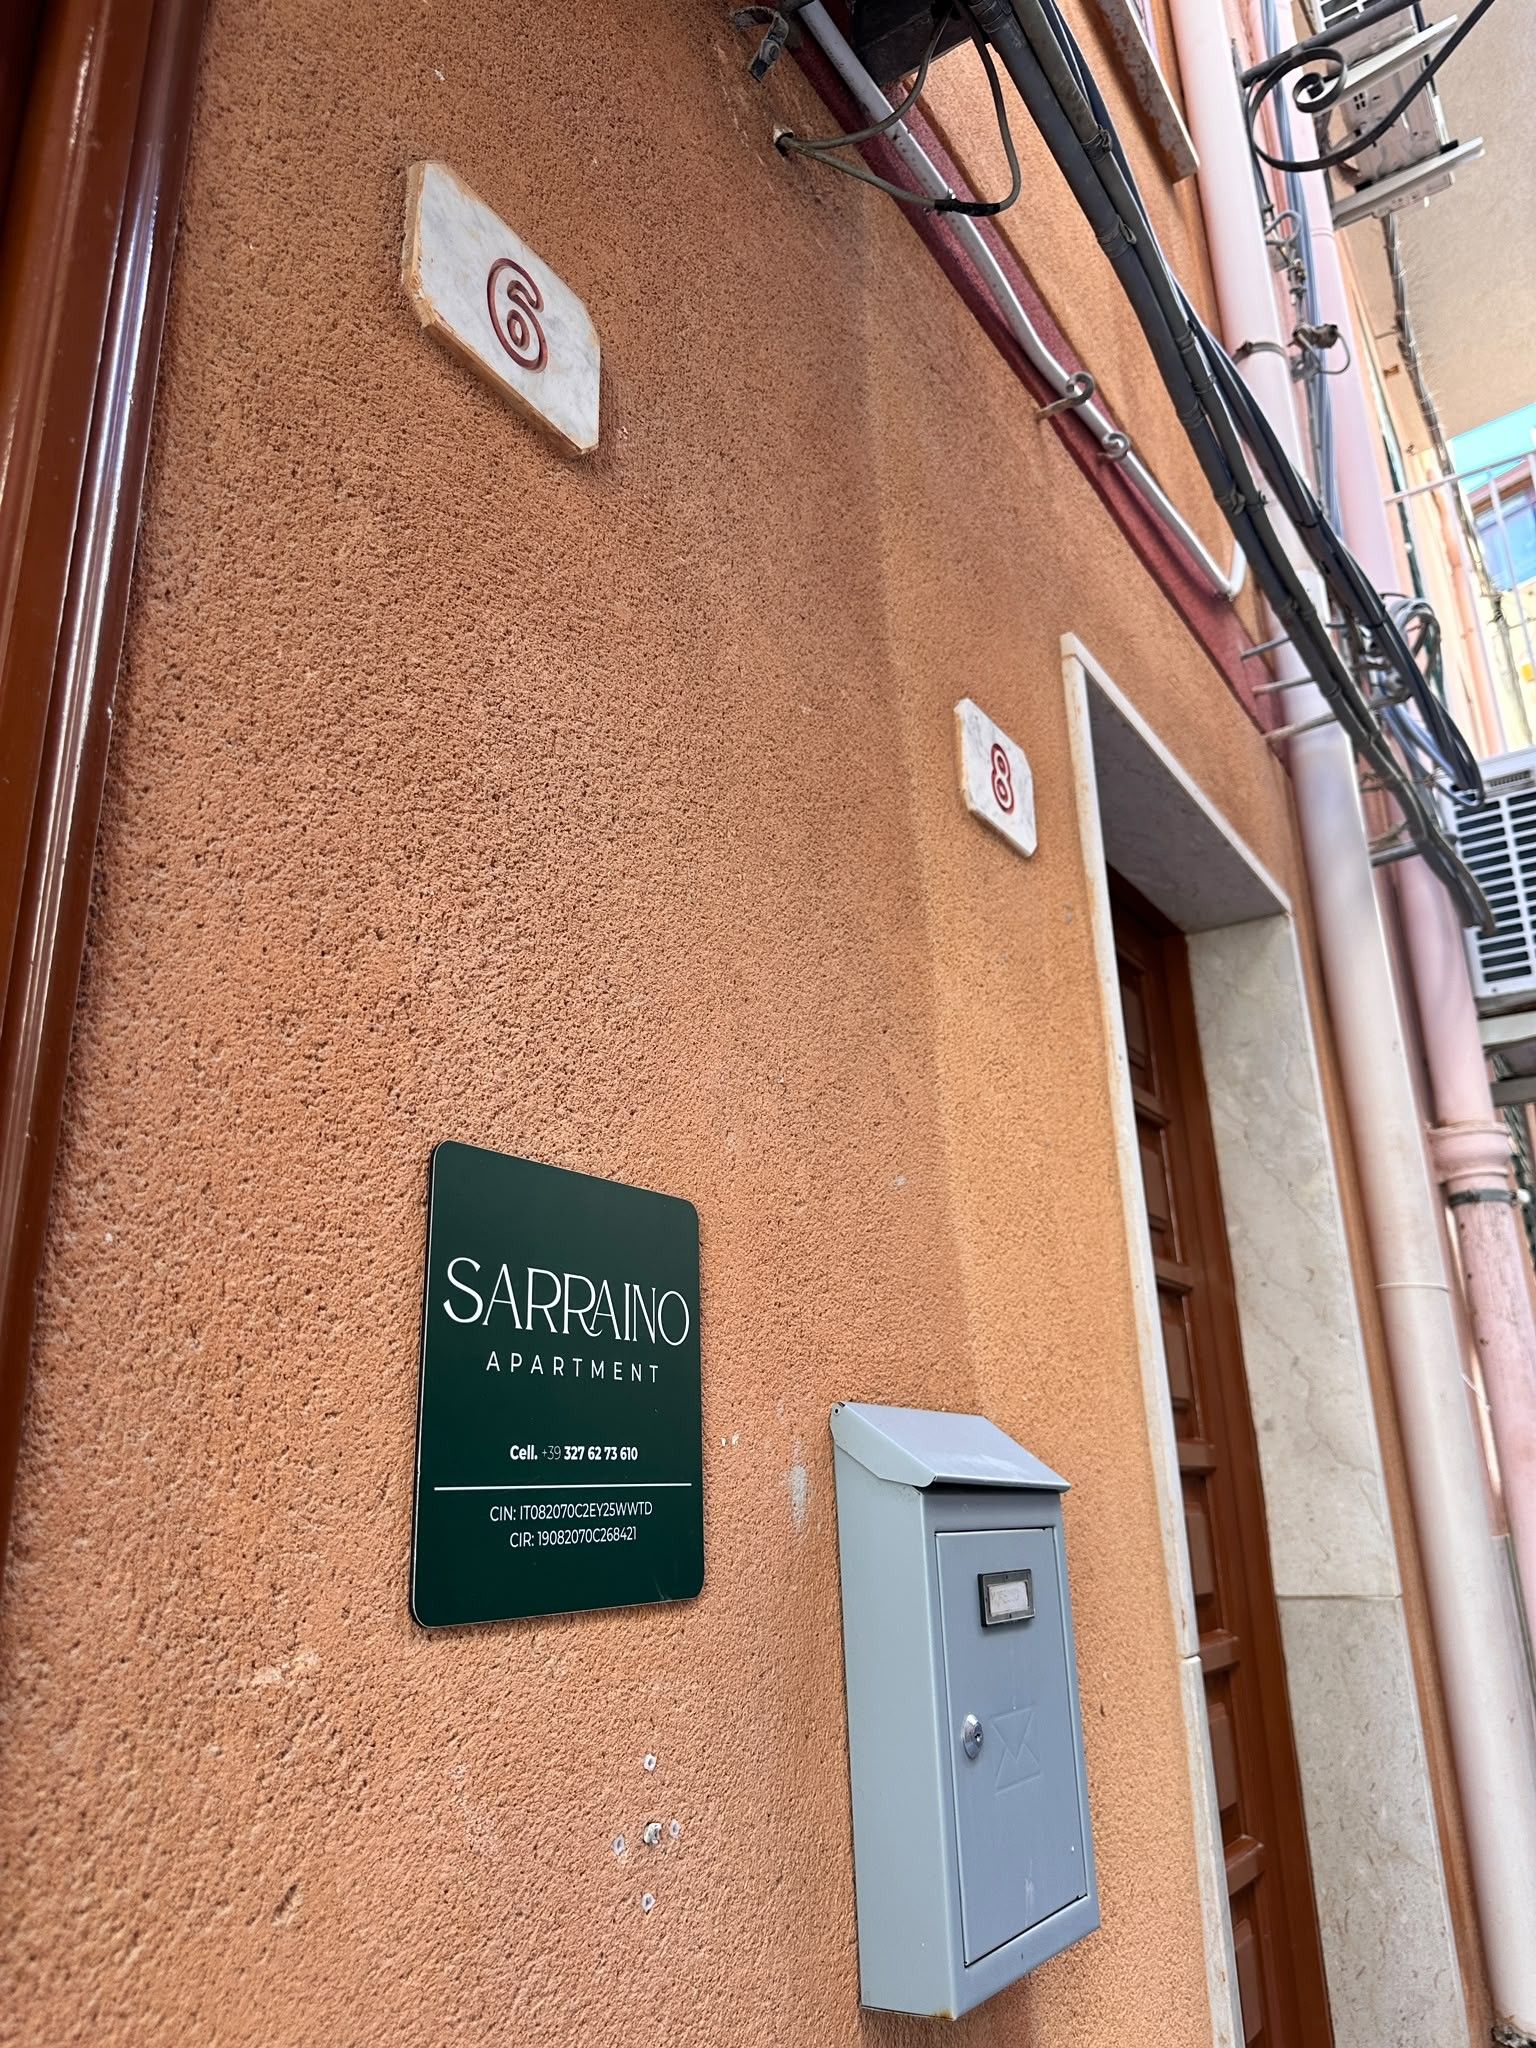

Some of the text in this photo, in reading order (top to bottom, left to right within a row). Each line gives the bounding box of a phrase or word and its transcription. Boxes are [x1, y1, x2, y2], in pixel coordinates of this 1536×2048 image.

[487, 258, 548, 373] 6
[990, 743, 1015, 816] 8
[443, 1257, 690, 1346] SARRAINO
[486, 1351, 659, 1383] APARTMENT
[509, 1444, 638, 1461] Cell. +39 327 62 73 610
[489, 1501, 653, 1522] CIN: IT082070C2EY25WWTD
[509, 1526, 637, 1548] CIR: 19082070C268421
